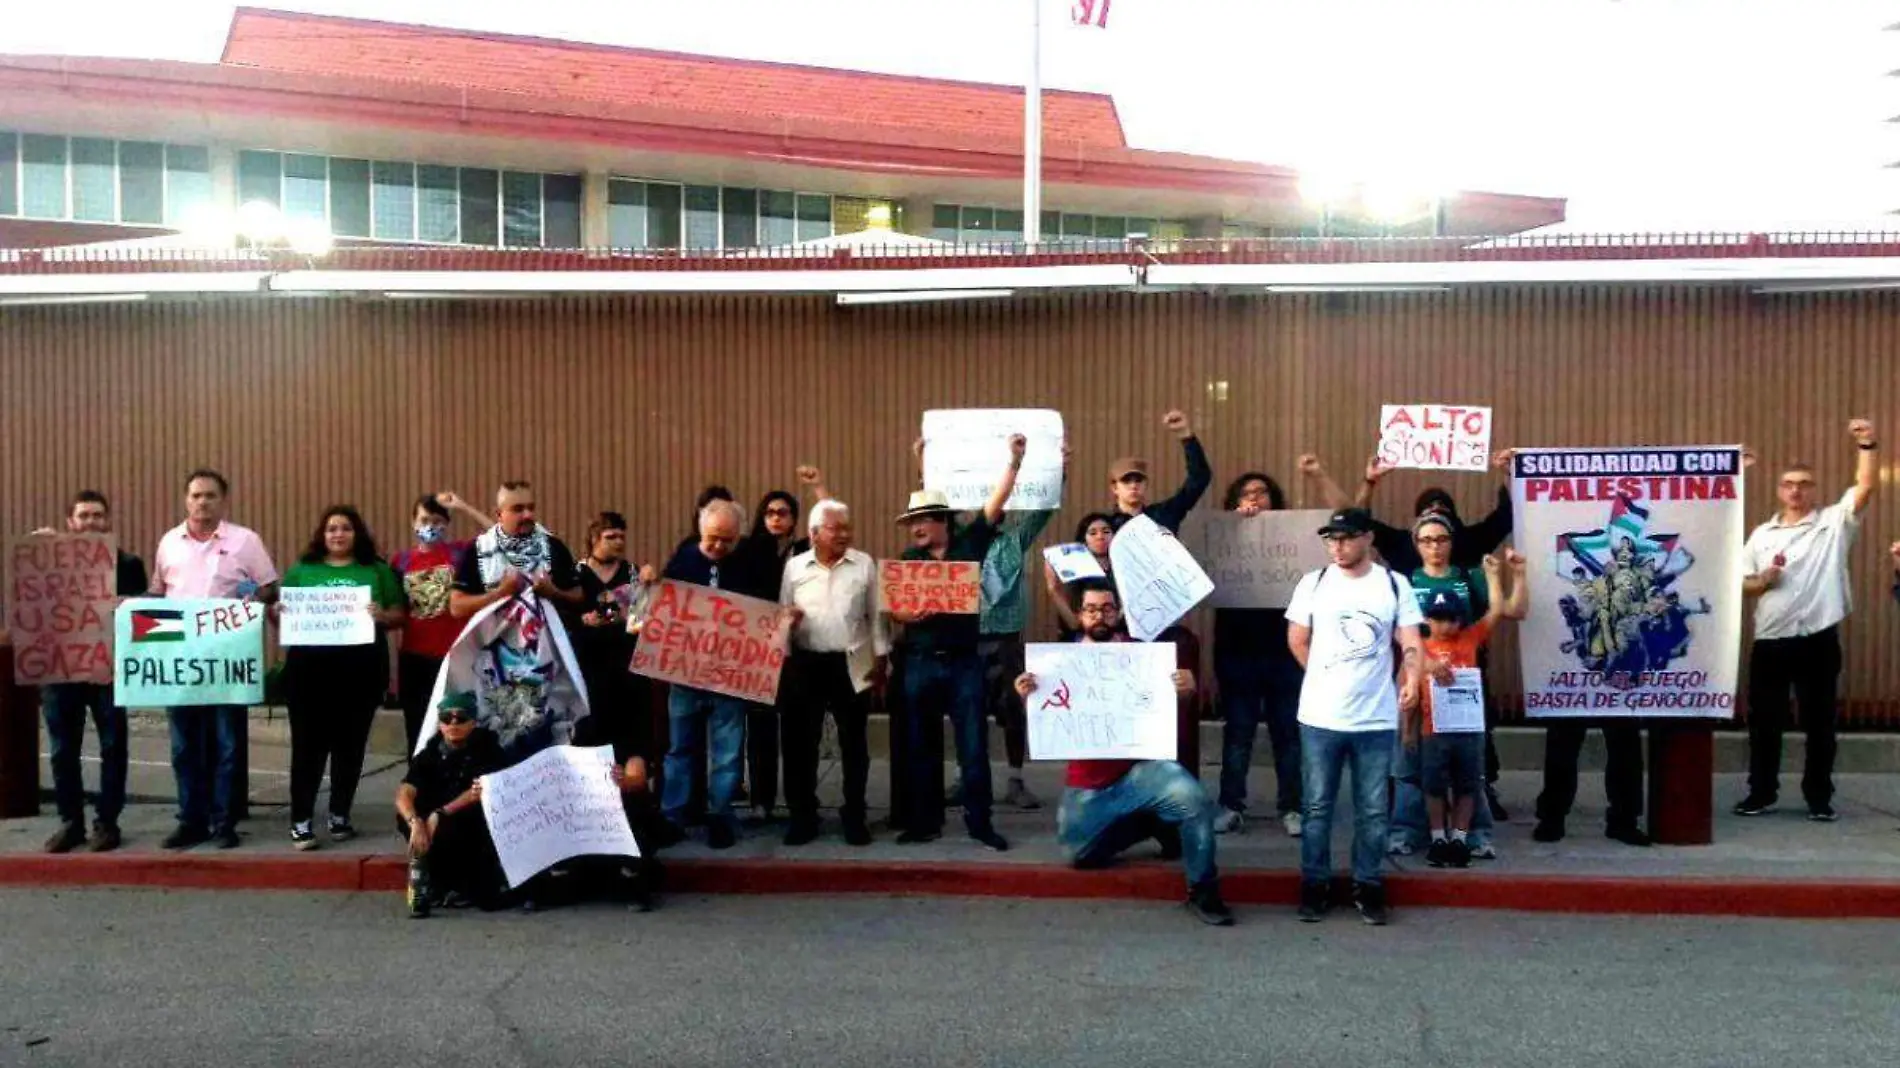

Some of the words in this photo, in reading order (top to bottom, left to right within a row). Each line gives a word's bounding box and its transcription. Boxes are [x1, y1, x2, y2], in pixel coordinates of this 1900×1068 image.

[1385, 407, 1483, 435] ALTO
[1522, 453, 1677, 474] SOLIDARIDAD
[1683, 452, 1732, 472] CON
[1525, 476, 1737, 501] PALESTINA
[14, 538, 113, 572] FUERA
[883, 562, 972, 581] STOP
[14, 572, 111, 601] ISRAEL
[15, 603, 103, 633] USA
[196, 597, 257, 637] FREE
[651, 583, 745, 628] ALTO
[889, 596, 969, 612] WAR
[18, 640, 110, 681] GAZA
[123, 657, 259, 687] PALESTINE
[659, 648, 773, 695] PALESTINA
[1549, 671, 1605, 688] ¡ALTO
[1641, 670, 1709, 688] FUEGO!
[1528, 692, 1588, 709] BASTA
[1592, 692, 1620, 709] DE
[1624, 691, 1733, 710] GENOCIDIO
